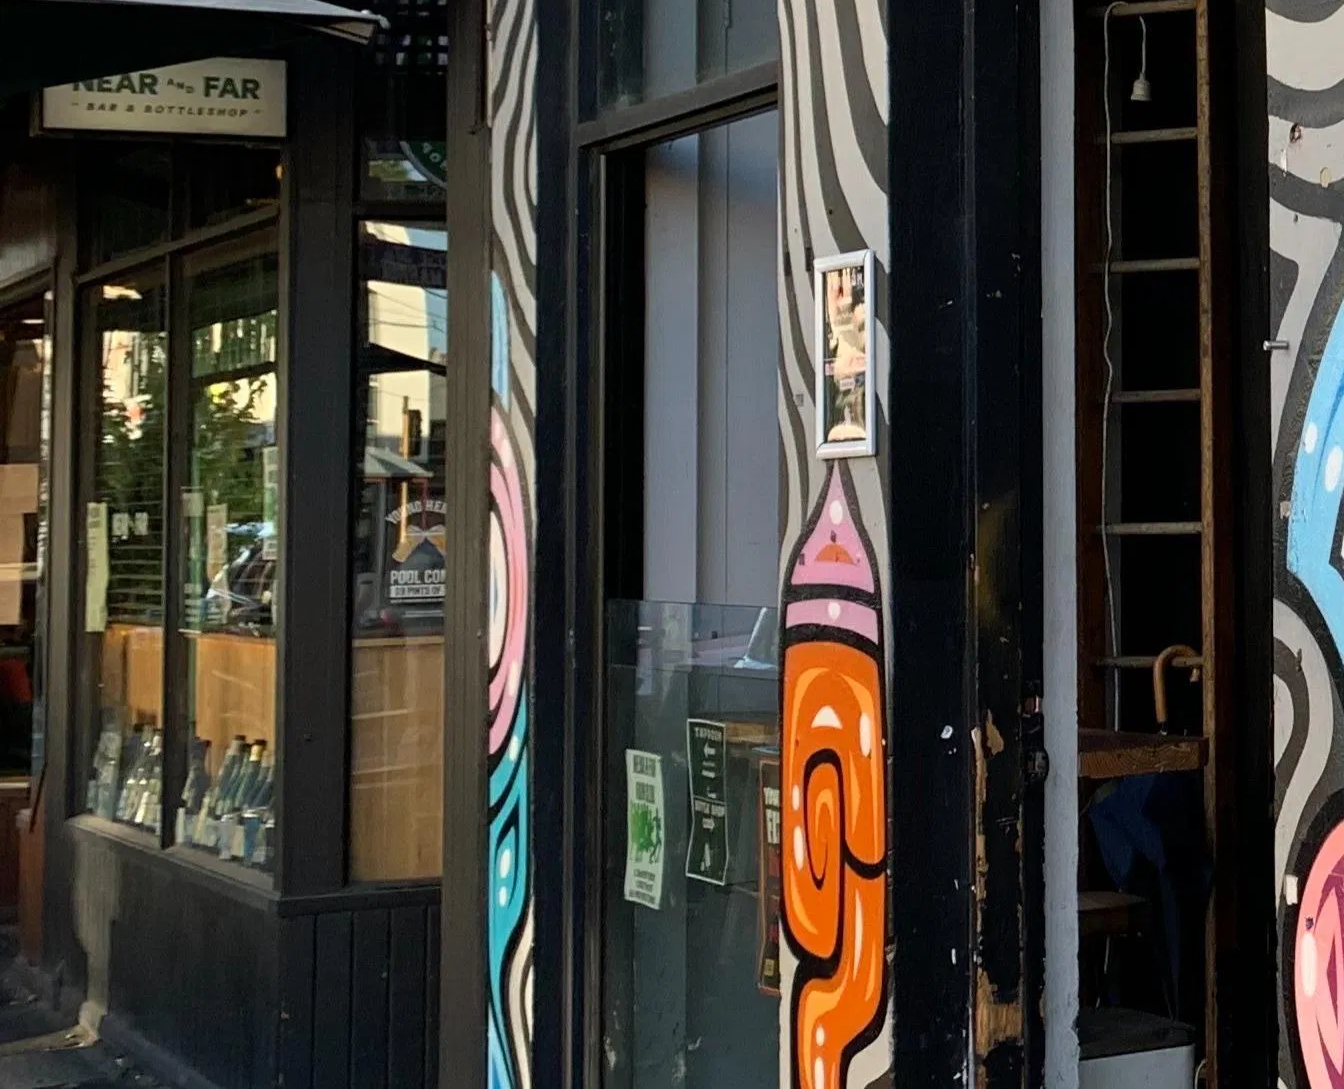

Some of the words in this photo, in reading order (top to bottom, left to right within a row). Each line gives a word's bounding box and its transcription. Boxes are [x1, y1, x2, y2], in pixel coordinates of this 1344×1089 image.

[202, 76, 261, 100] FAR
[86, 102, 118, 112] BAR
[143, 104, 250, 118] BOTTLESHOP
[390, 569, 421, 585] POOL
